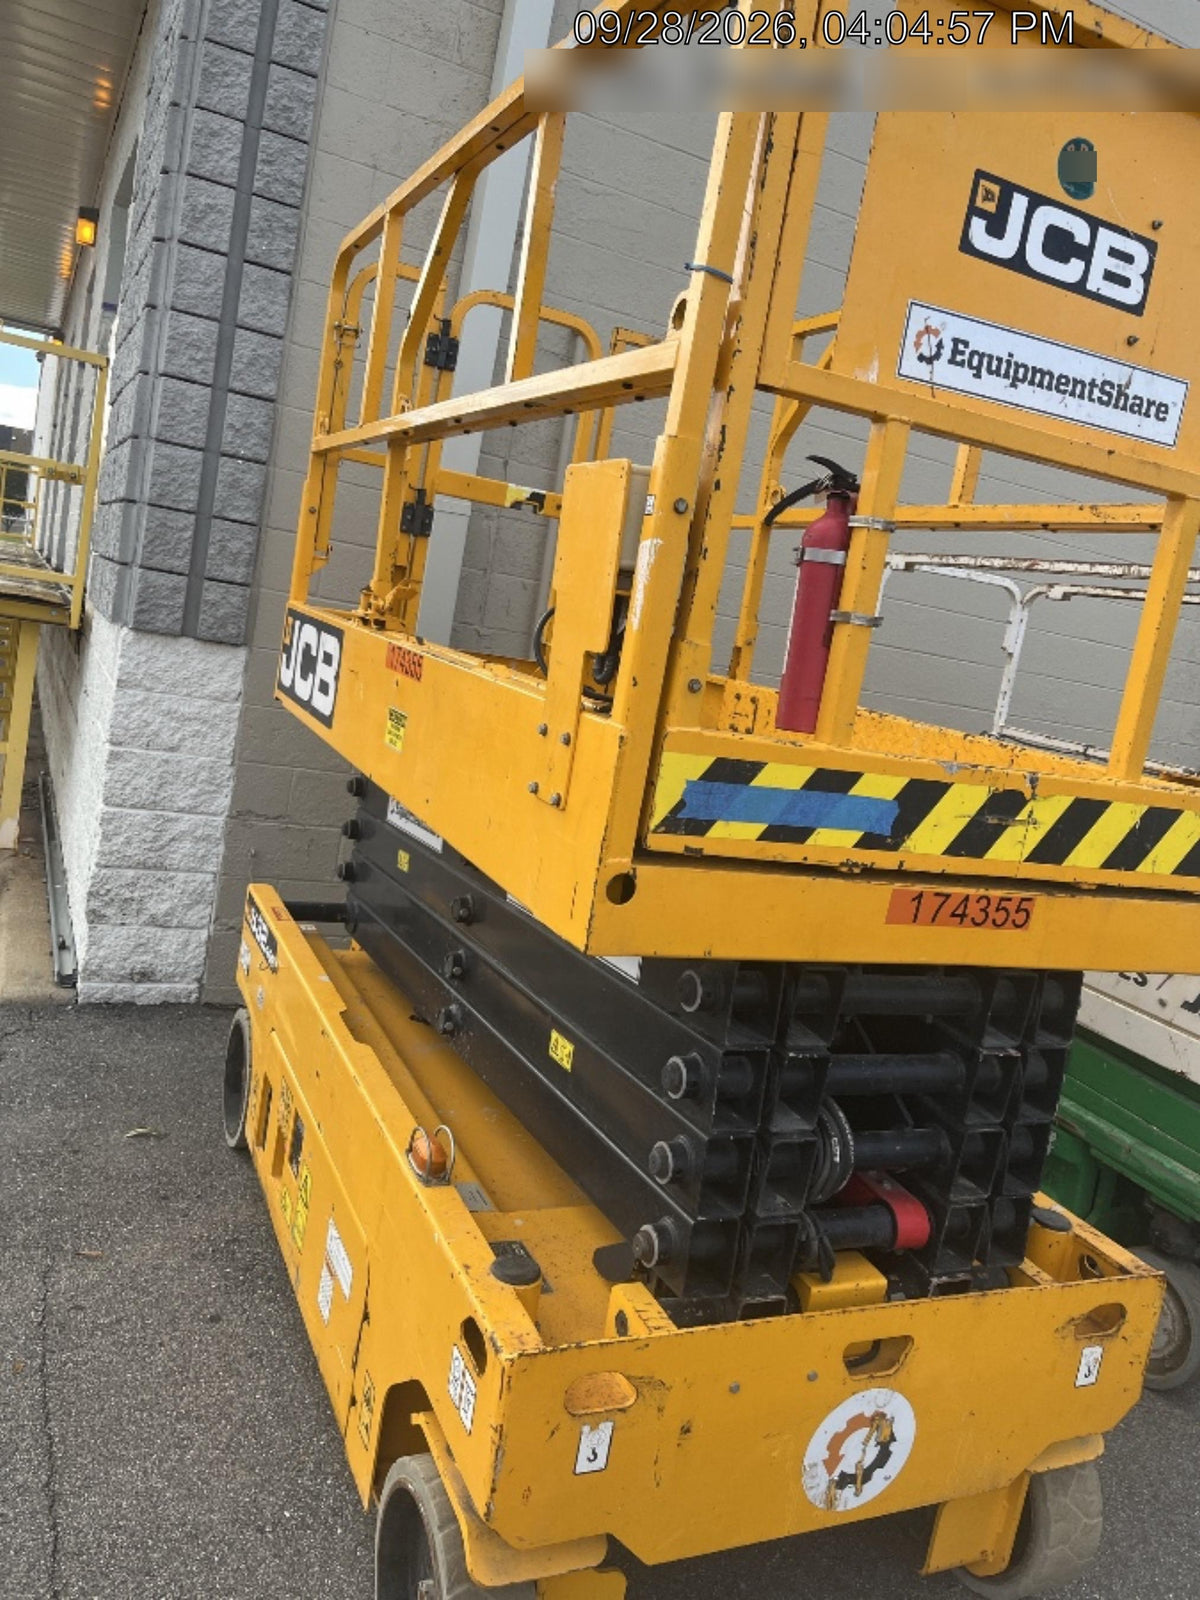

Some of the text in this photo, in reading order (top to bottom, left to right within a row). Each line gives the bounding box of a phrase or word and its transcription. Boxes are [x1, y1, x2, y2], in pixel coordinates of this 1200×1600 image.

[968, 191, 1150, 306] JCB
[947, 336, 1170, 423] EquipmentShare
[280, 619, 340, 717] JCB
[911, 890, 1035, 929] 174355
